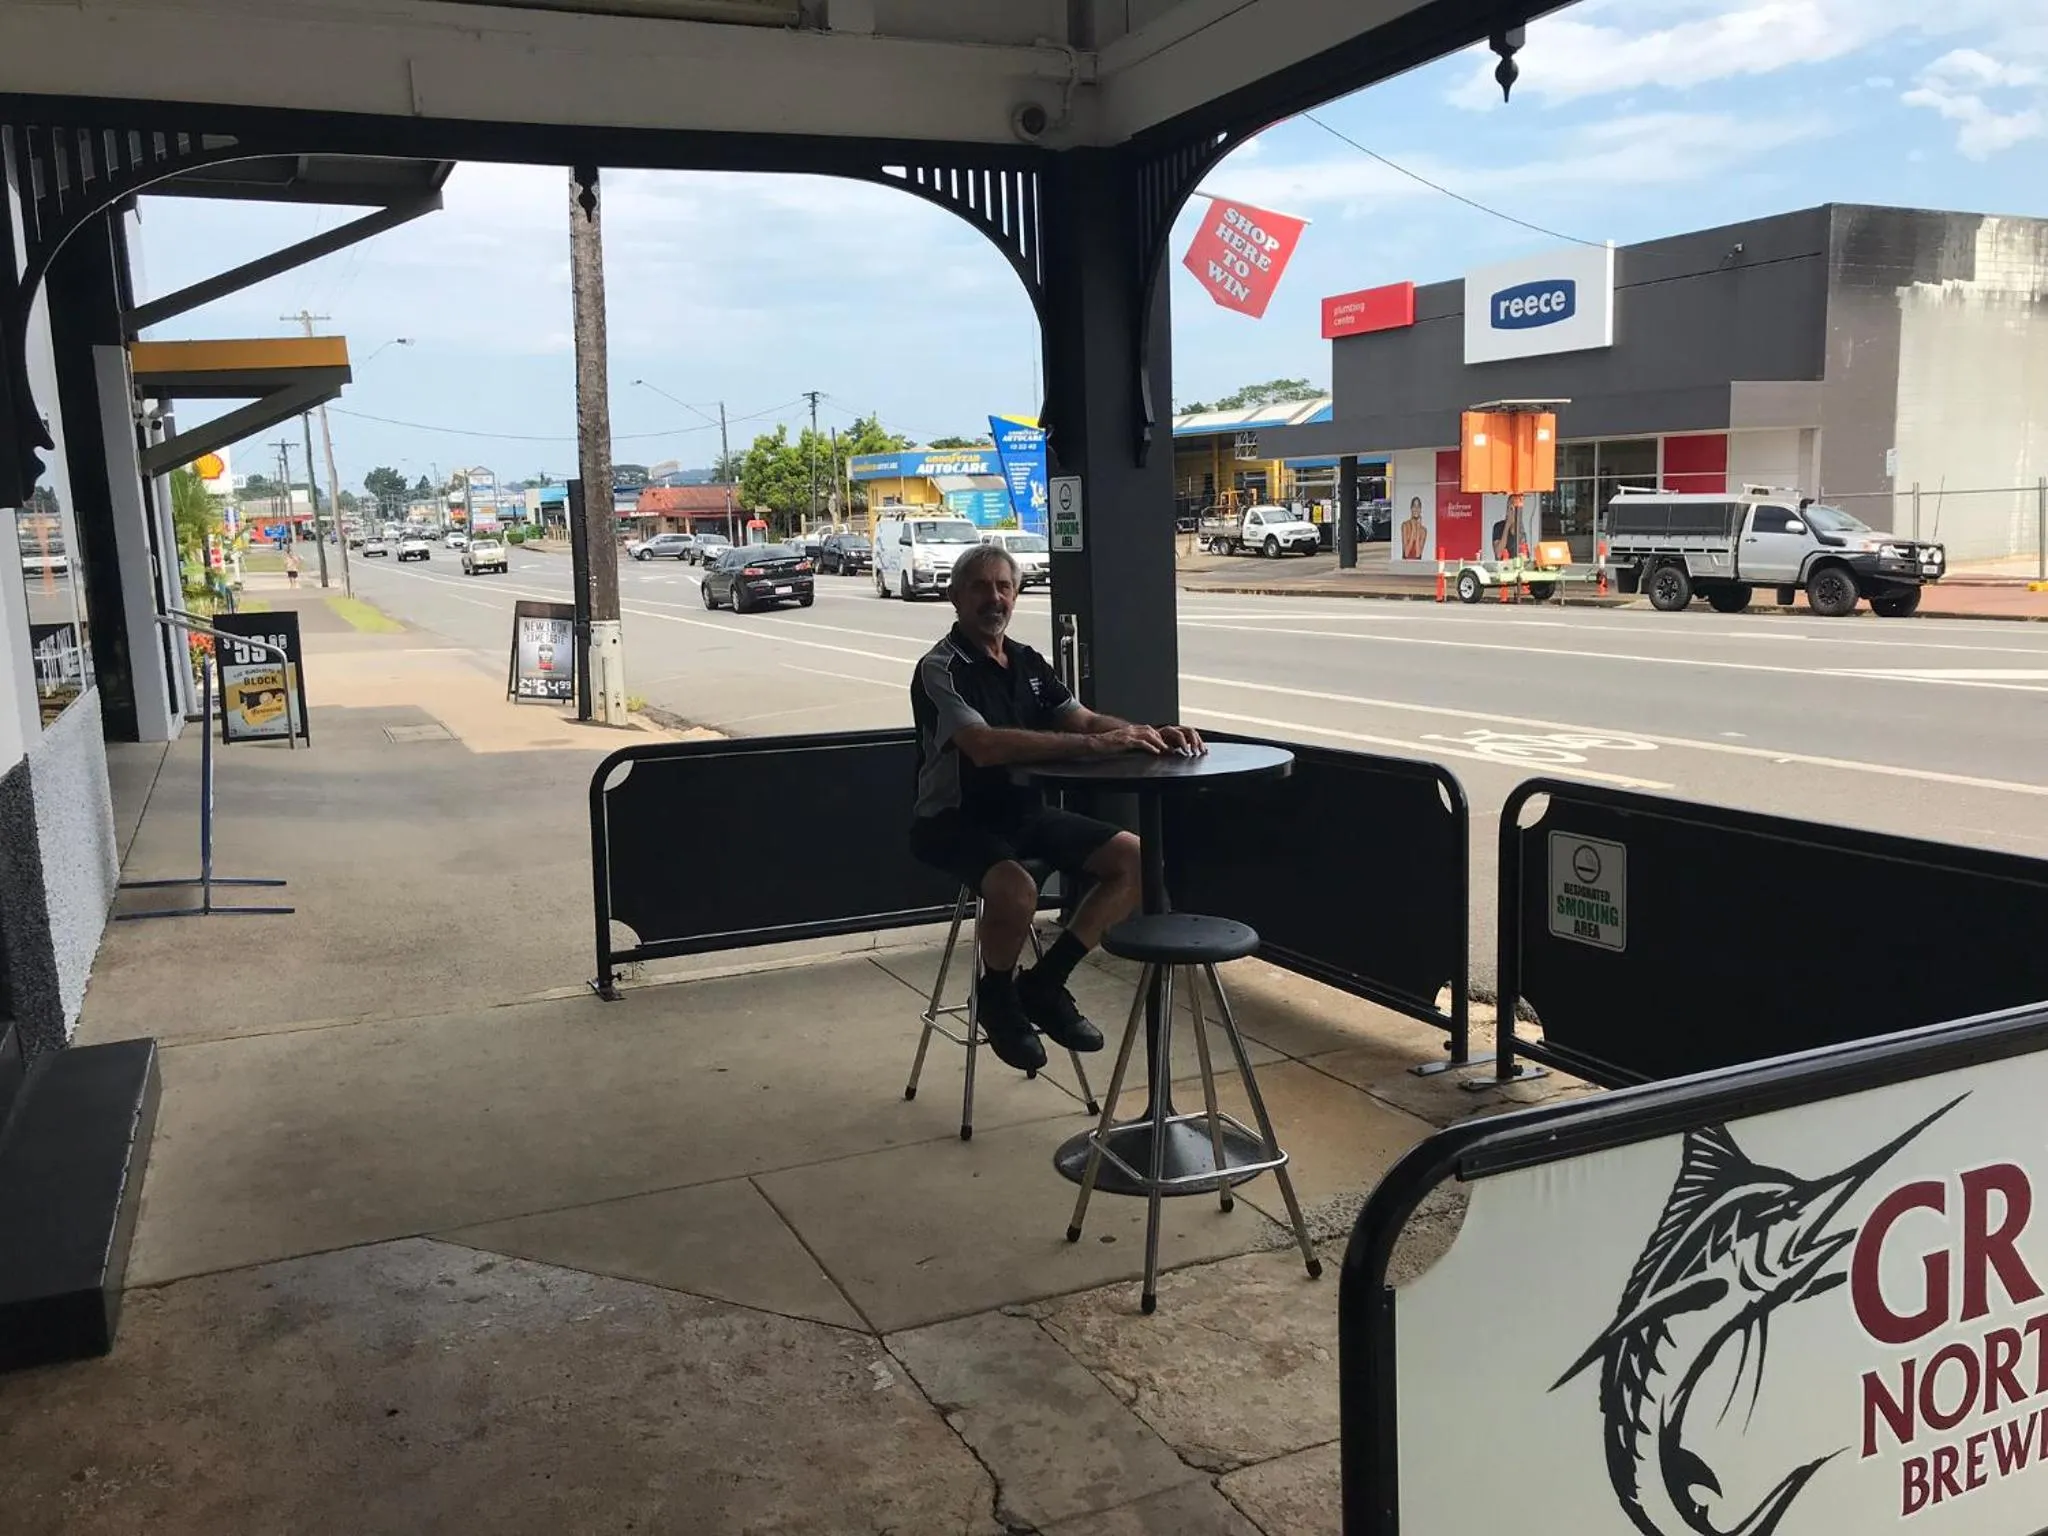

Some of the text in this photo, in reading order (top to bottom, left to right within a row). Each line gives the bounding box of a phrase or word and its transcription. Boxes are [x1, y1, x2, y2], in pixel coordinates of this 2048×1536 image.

[1223, 207, 1280, 252] SHOP
[1216, 222, 1272, 272] HERE
[1222, 249, 1250, 278] TO
[1209, 260, 1250, 302] WIN
[1500, 289, 1566, 320] reece
[916, 462, 989, 475] AUTOCARE
[925, 454, 981, 463] GOODYEAR
[524, 621, 544, 632] NEW
[244, 675, 278, 686] BLOCK
[1557, 895, 1619, 927] SMOKING
[1574, 919, 1600, 939] AREA
